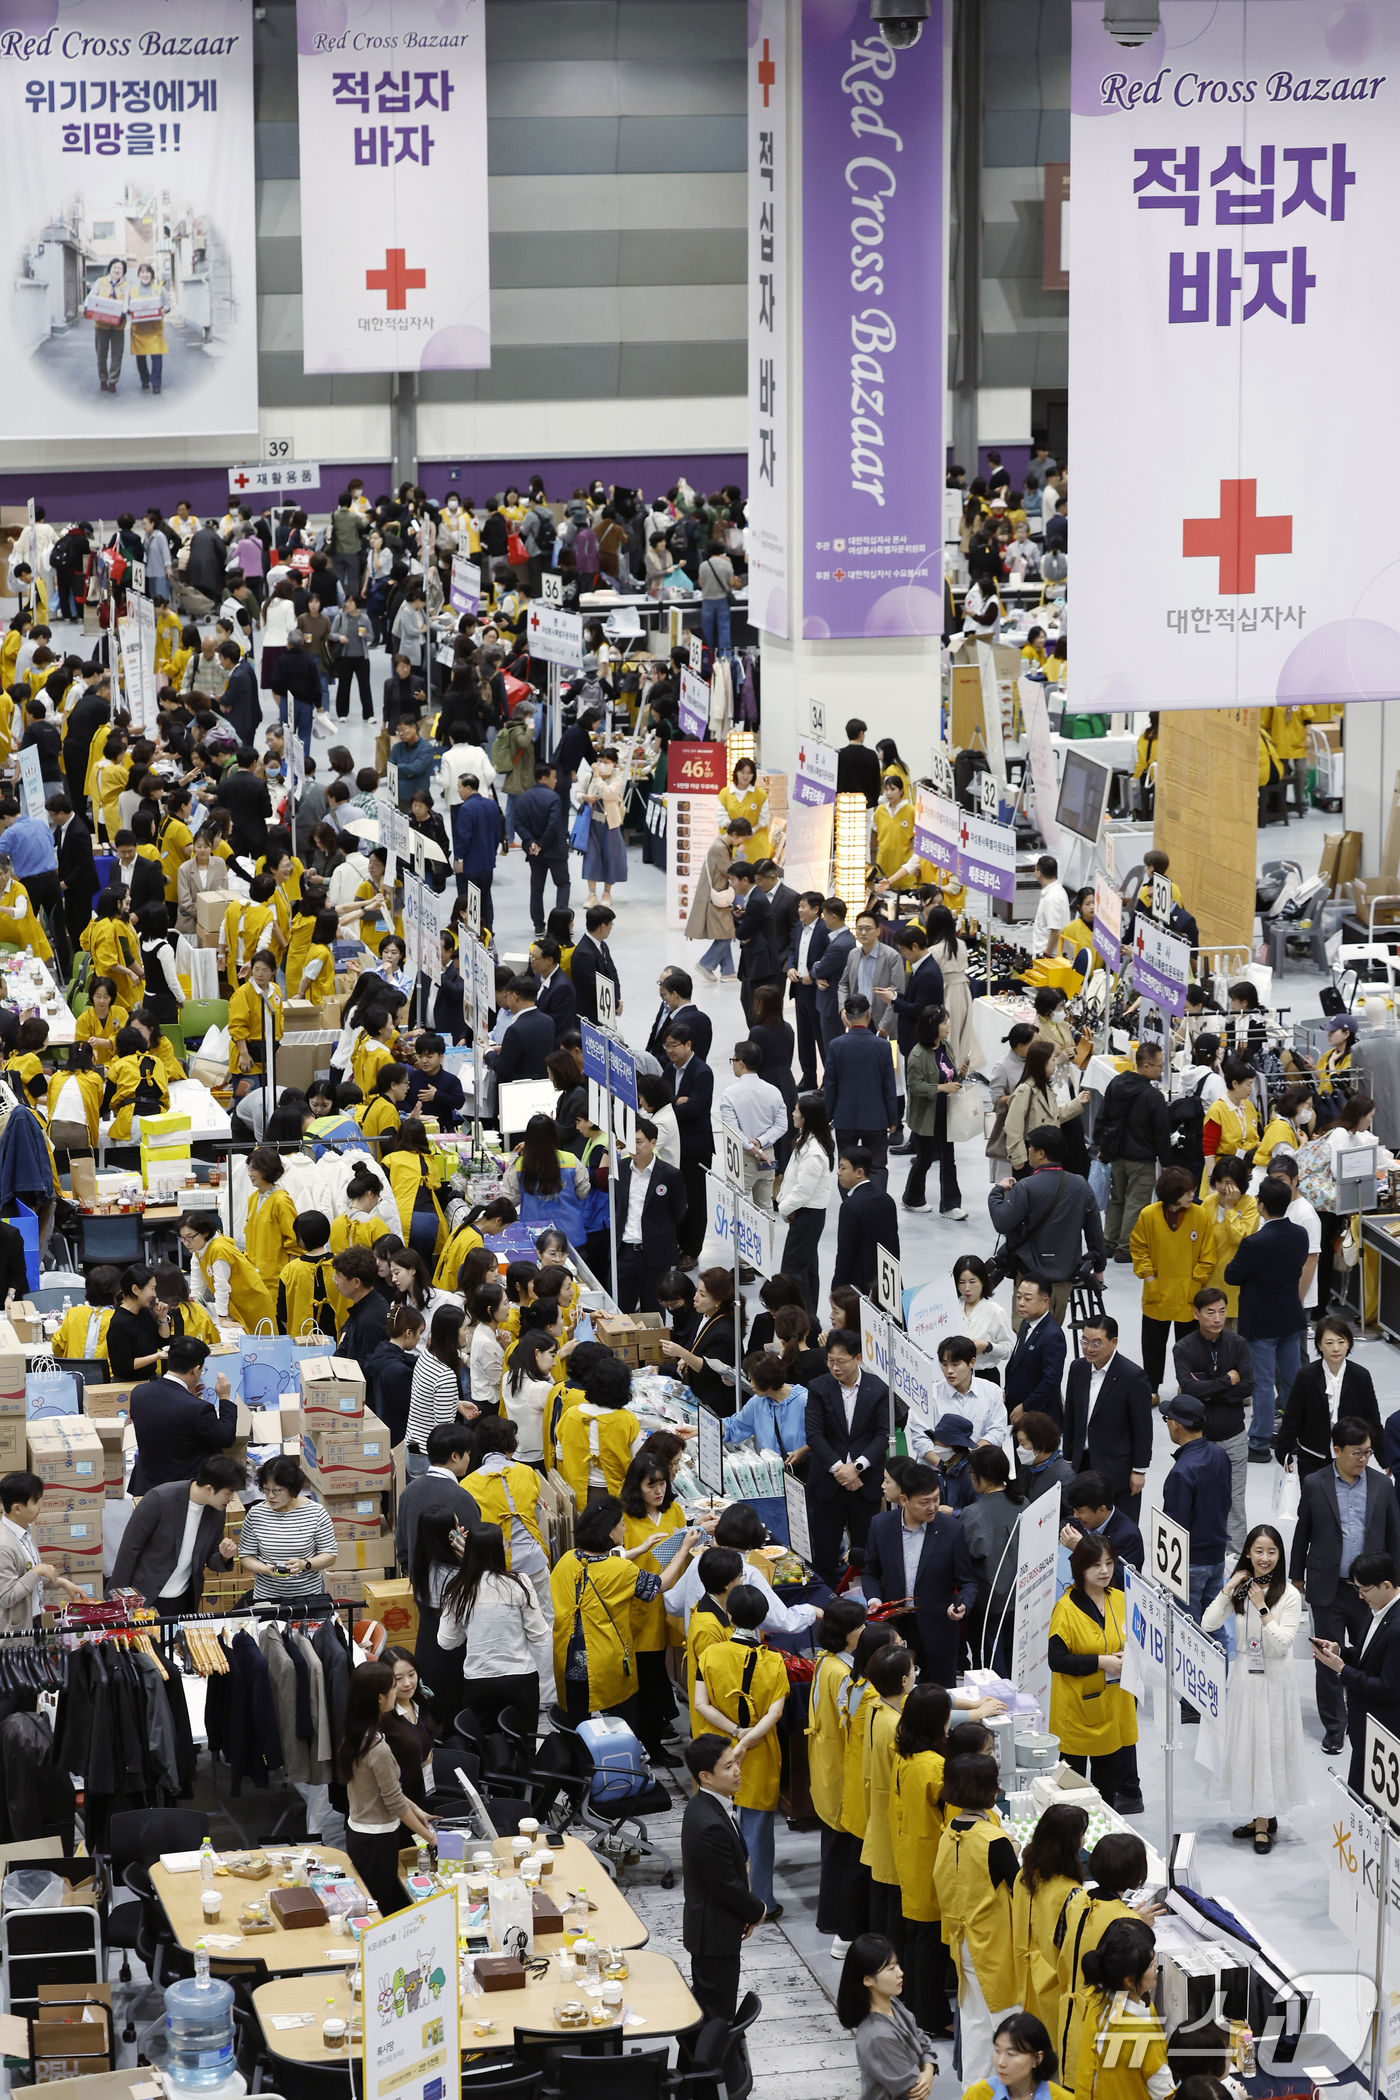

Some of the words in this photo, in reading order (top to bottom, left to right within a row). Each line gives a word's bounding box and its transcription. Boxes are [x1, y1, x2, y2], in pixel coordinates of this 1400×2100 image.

[1, 28, 58, 60] Red
[62, 30, 132, 59] Cross
[140, 31, 240, 57] Bazaar
[313, 31, 347, 52] Red
[353, 31, 399, 50] Cross
[403, 31, 469, 51] Bazaar
[25, 79, 219, 113] 위기가정에게
[332, 69, 455, 113] 적십자
[841, 34, 903, 152] Red
[1101, 69, 1168, 109] Red
[1172, 72, 1257, 107] Cross
[1268, 72, 1386, 103] Bazaar
[61, 122, 182, 156] 희망을!!
[354, 125, 435, 167] 바자
[1133, 143, 1356, 226] 적십자
[759, 131, 775, 333] 적십자
[845, 157, 897, 296] Cross
[1168, 246, 1316, 327] 바자
[357, 315, 435, 333] 대한적십자사
[758, 358, 776, 487] 바자
[850, 307, 897, 506] Bazaar
[268, 442, 289, 457] 39
[256, 469, 313, 485] 재활용품
[815, 541, 831, 551] 주관
[847, 534, 892, 546] 대한적십자사
[892, 534, 908, 544] 본사
[134, 567, 142, 587] 43
[544, 580, 559, 599] 36
[847, 569, 892, 580] 대한적십자사
[892, 567, 929, 579] 수요봉사회
[1165, 604, 1306, 634] 대한적십자사
[691, 641, 700, 665] 35
[812, 705, 823, 731] 34
[681, 760, 704, 778] 46
[704, 760, 712, 772] %
[933, 756, 944, 782] 33
[389, 771, 396, 798] 46
[983, 780, 996, 809] 32
[468, 892, 478, 925] 48
[1155, 882, 1167, 914] 30
[600, 985, 612, 1019] 49
[584, 1035, 606, 1065] 신한은행
[726, 1136, 740, 1179] 50
[715, 1203, 729, 1240] Sh
[729, 1215, 762, 1267] 수협은행
[882, 1260, 896, 1308] 51
[892, 1360, 929, 1415] 농협은행
[1038, 1552, 1055, 1573] BAZAAR
[1156, 1526, 1182, 1586] 52
[1150, 1623, 1167, 1668] IB
[1180, 1629, 1206, 1664] 배우자반
[1175, 1647, 1219, 1718] 기업은행
[1371, 1737, 1400, 1808] 53
[1350, 1811, 1379, 1852] 금융기관
[35, 2060, 79, 2075] DELI
